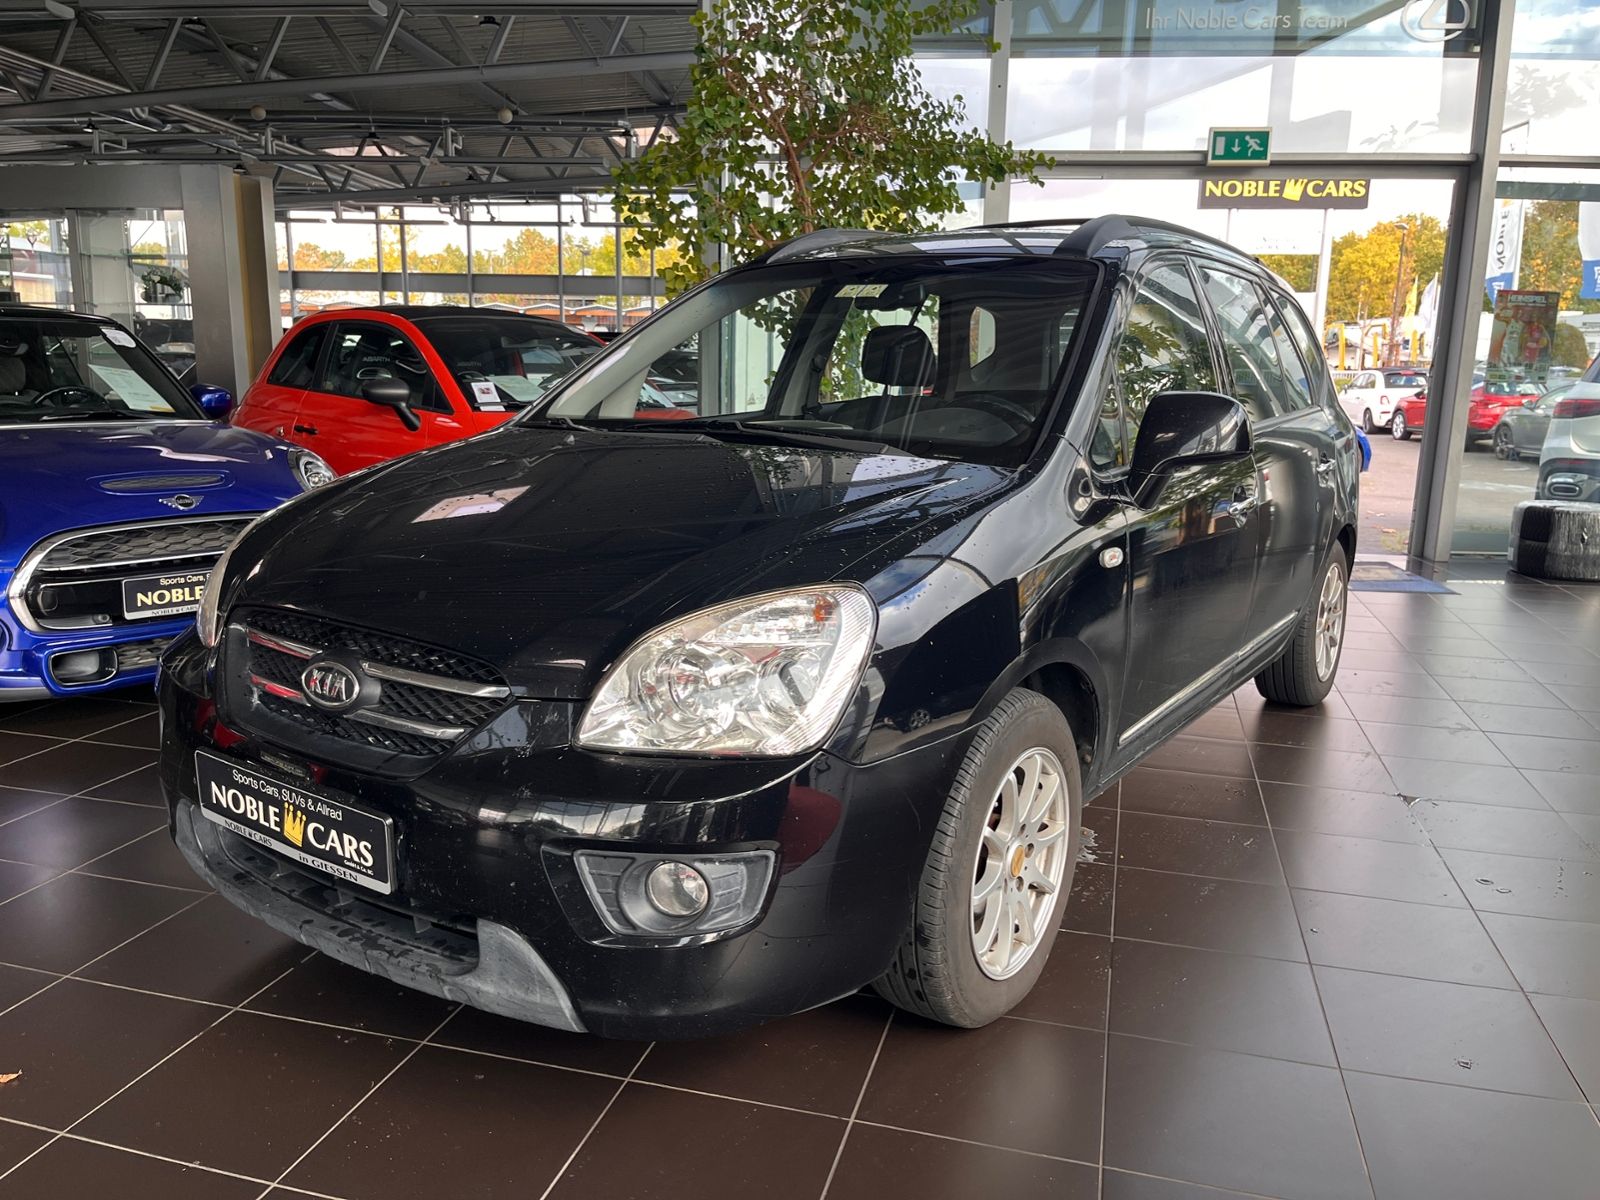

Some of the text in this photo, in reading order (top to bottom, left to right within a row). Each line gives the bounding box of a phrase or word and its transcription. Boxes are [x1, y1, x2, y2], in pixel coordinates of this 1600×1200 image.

[1145, 6, 1348, 30] Ihr Noble Cars Team
[1205, 179, 1366, 198] NOBLE CARS
[160, 576, 186, 587] Sports
[186, 574, 206, 584] Cars,
[136, 585, 205, 607] NOBLE
[308, 668, 348, 701] KIA
[232, 769, 343, 821] Sports Cars, SUVs & Allrad
[210, 780, 375, 867] NOBLE CARS
[224, 819, 273, 848] NOBLE CARS
[298, 853, 358, 882] in GIESSEN
